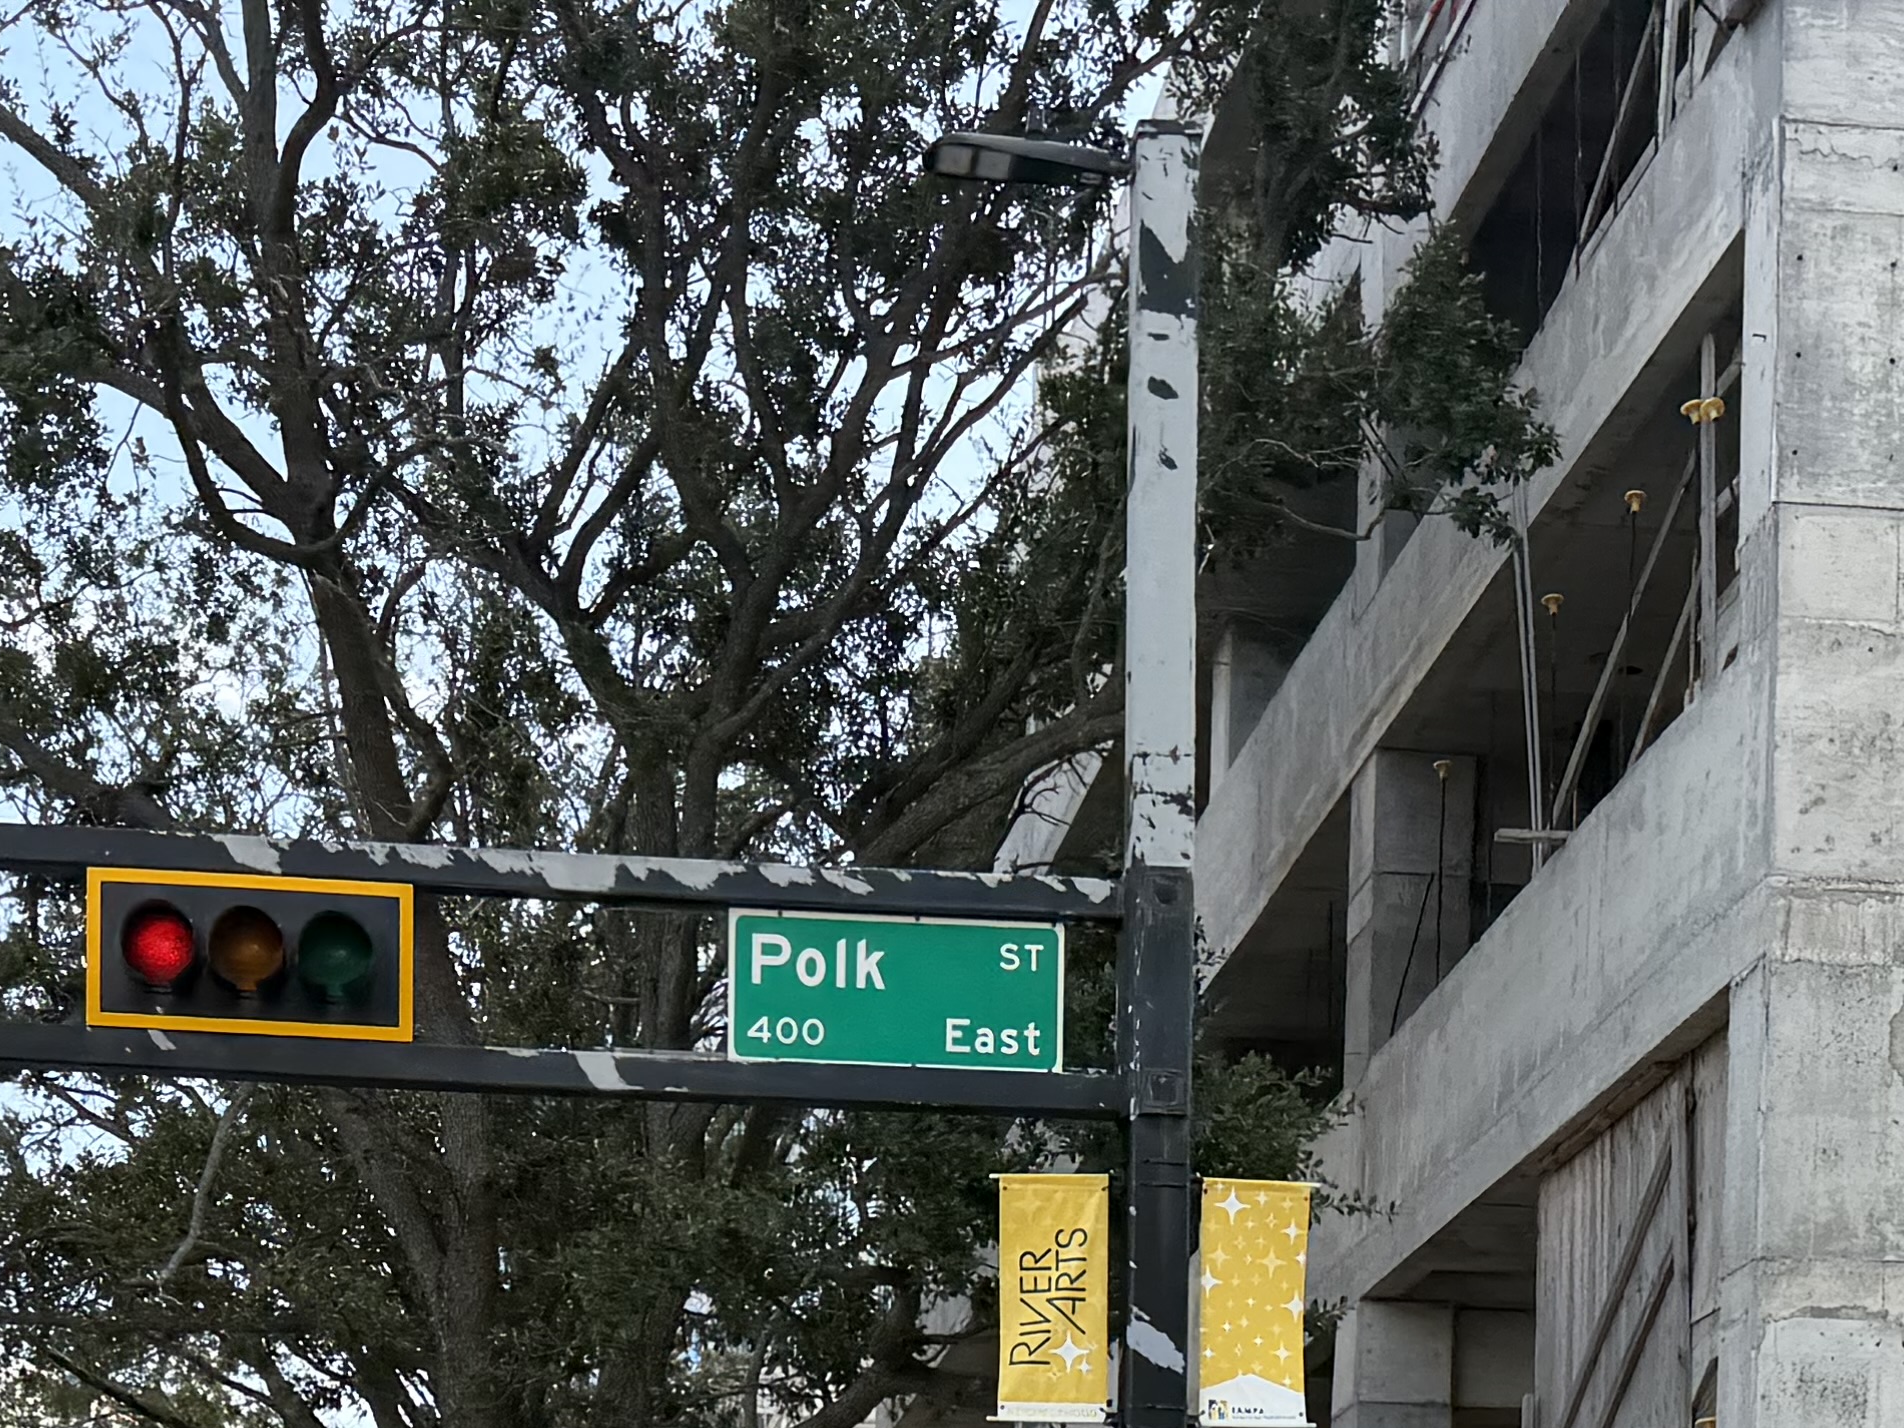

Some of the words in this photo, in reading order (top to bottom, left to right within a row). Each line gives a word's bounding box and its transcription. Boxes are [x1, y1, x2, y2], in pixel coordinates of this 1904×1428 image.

[751, 933, 886, 990] Polk
[999, 942, 1045, 972] ST
[747, 1016, 826, 1046] 400
[945, 1017, 1041, 1056] East
[1008, 1247, 1053, 1366] RIVER
[1045, 1227, 1089, 1336] ARTS
